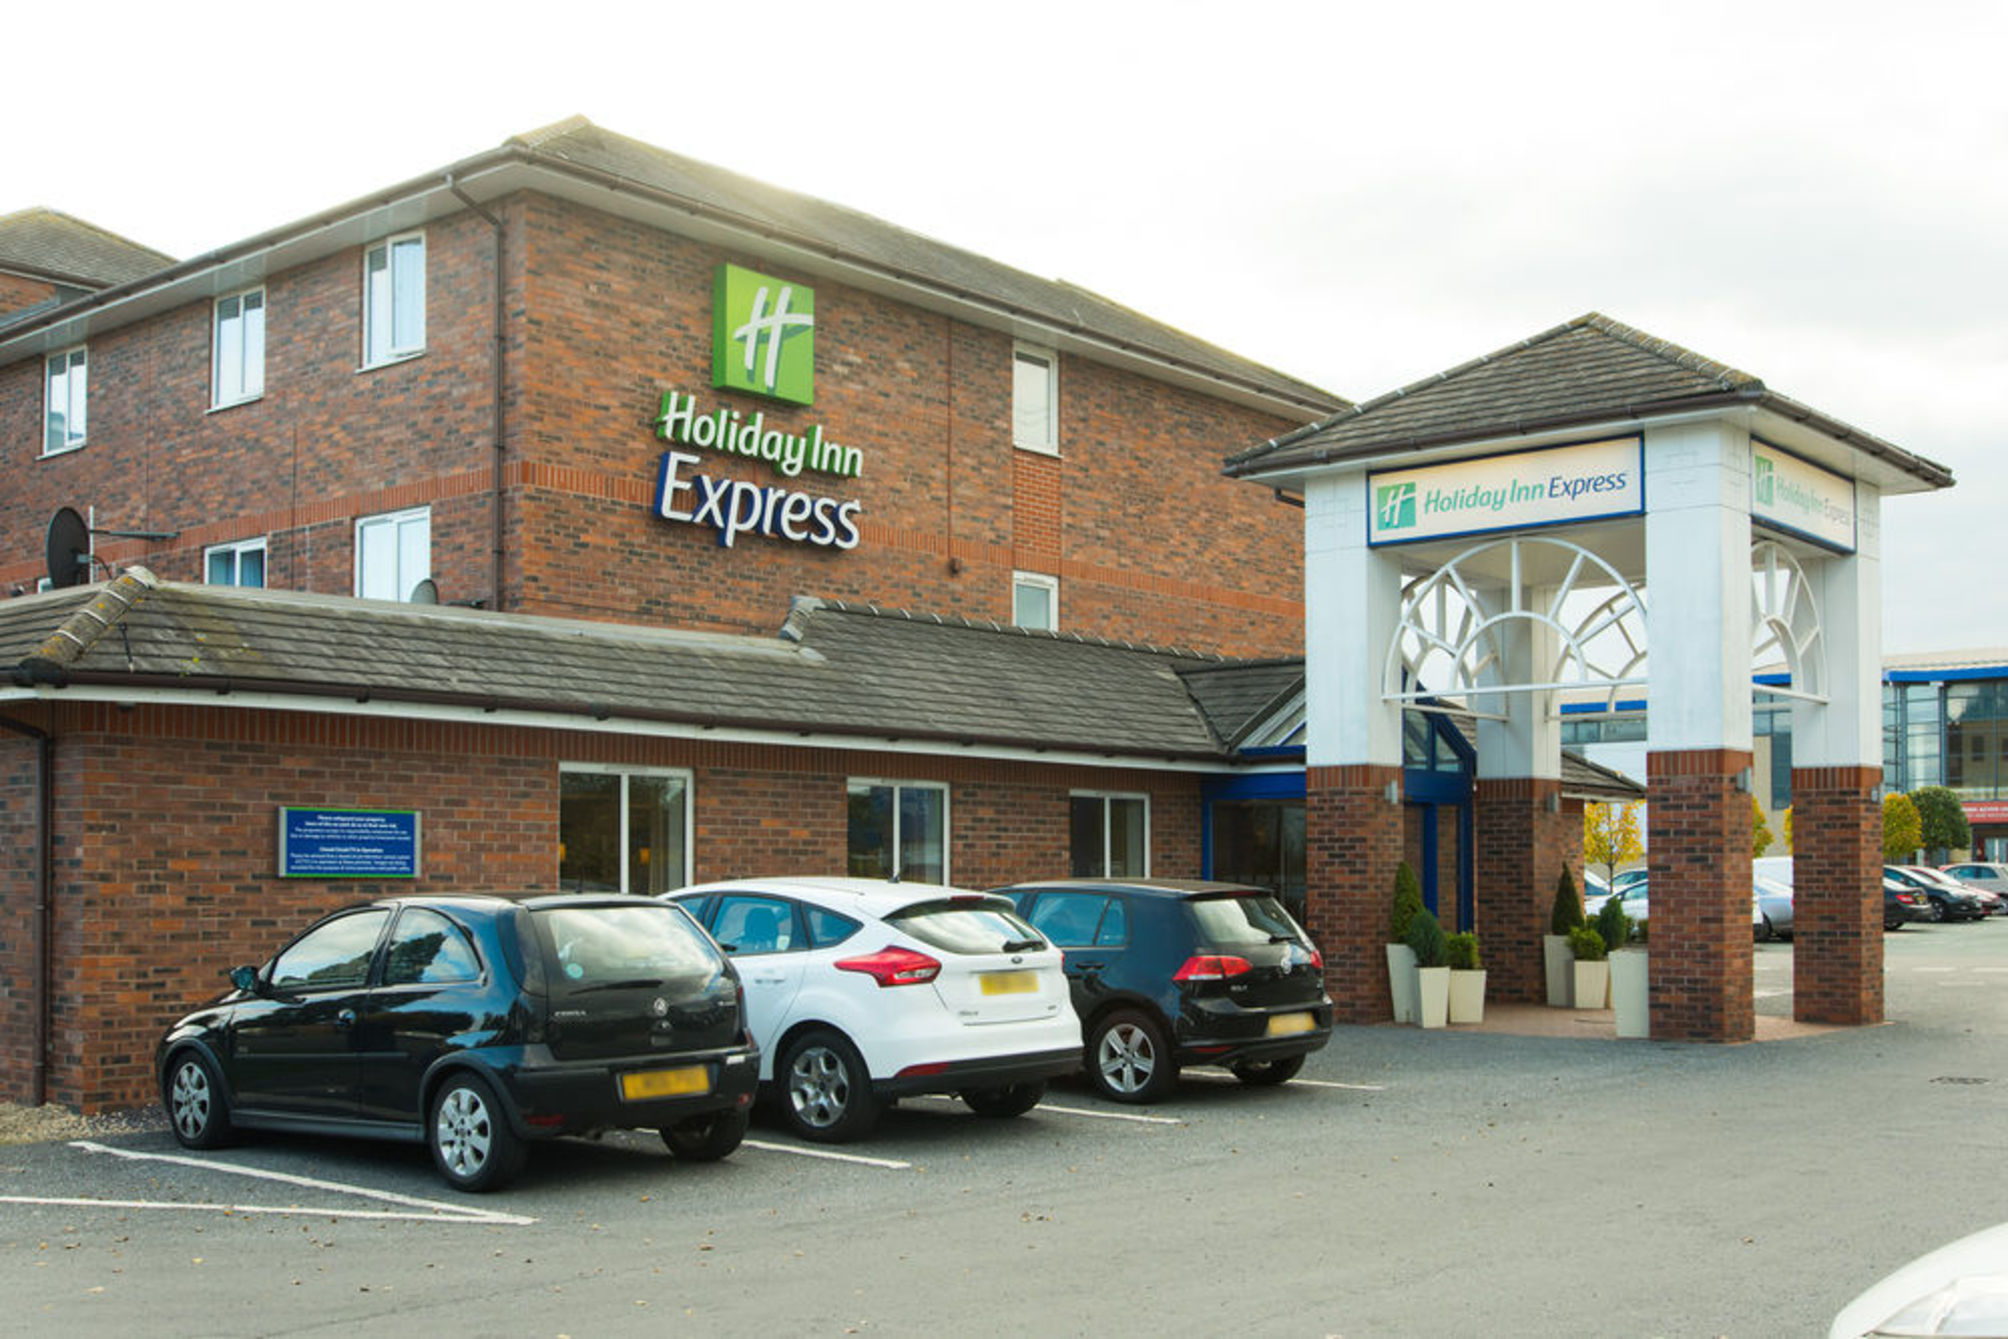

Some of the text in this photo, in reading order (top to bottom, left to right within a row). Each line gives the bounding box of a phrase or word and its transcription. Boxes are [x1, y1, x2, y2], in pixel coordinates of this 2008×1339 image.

[656, 390, 864, 478] Holiday Inn
[654, 450, 862, 548] Express
[1424, 471, 1627, 514] Holiday Inn Express
